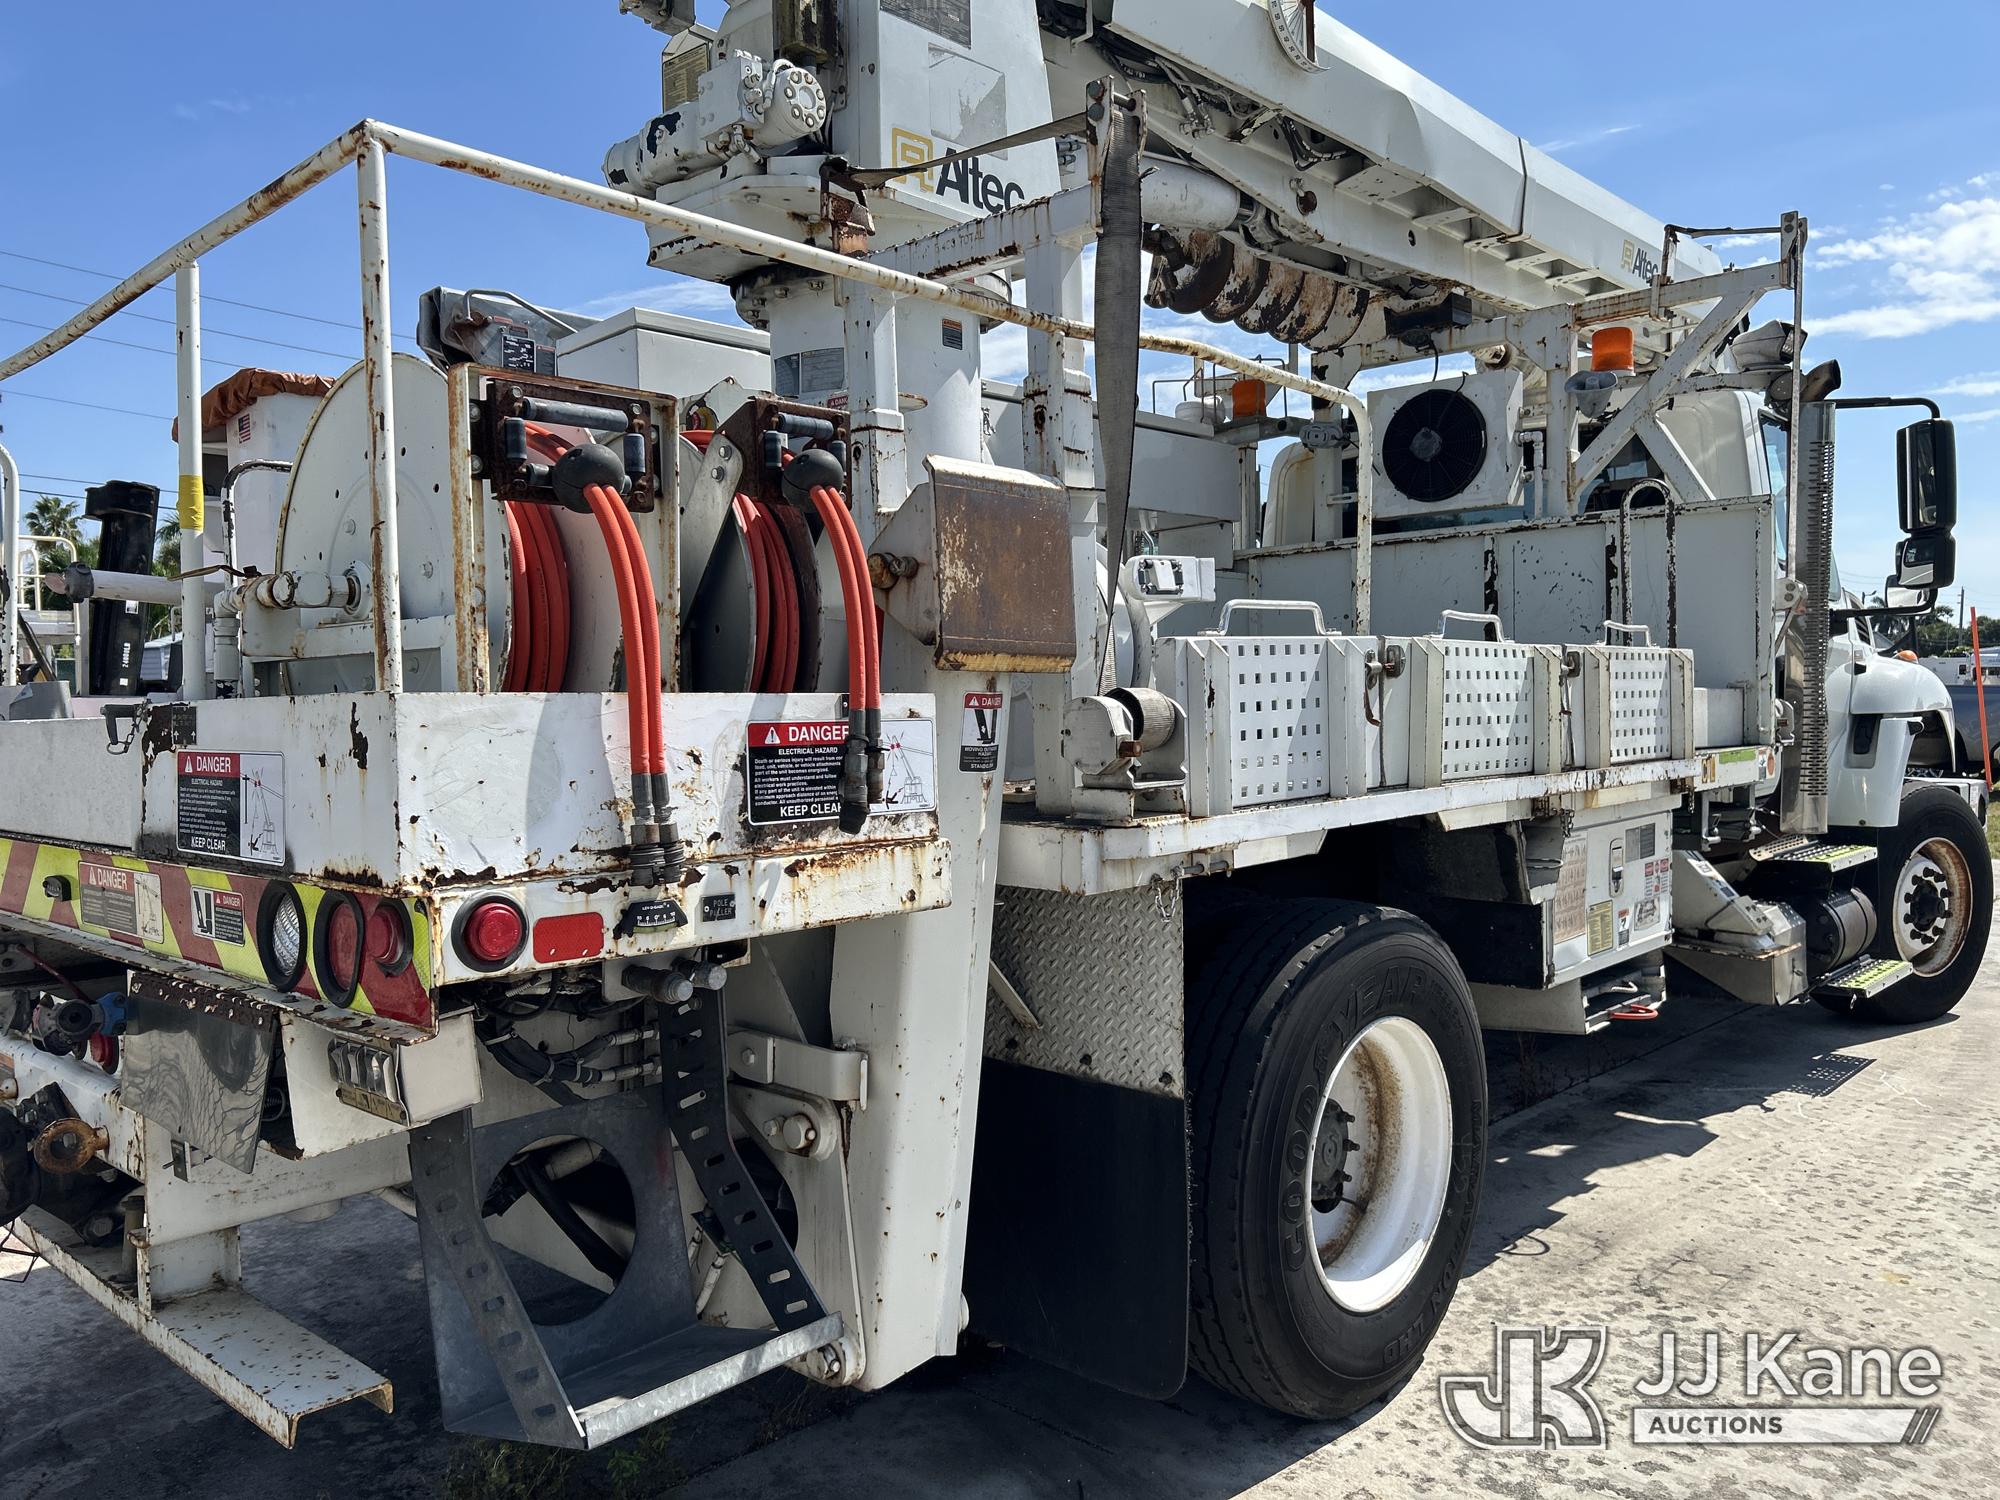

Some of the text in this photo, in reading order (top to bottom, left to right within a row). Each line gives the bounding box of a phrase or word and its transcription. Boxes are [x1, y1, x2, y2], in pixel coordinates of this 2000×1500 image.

[936, 147, 1025, 215] Altec
[1632, 248, 1659, 287] Altec
[778, 746, 838, 756] ELECTRICAL HAZARD
[196, 756, 231, 773] DANGER
[780, 805, 808, 817] KEEP
[191, 837, 226, 851] KEEP CLEAR
[97, 868, 128, 891] DANGER
[222, 895, 240, 907] DANGER
[713, 899, 728, 907] POLE
